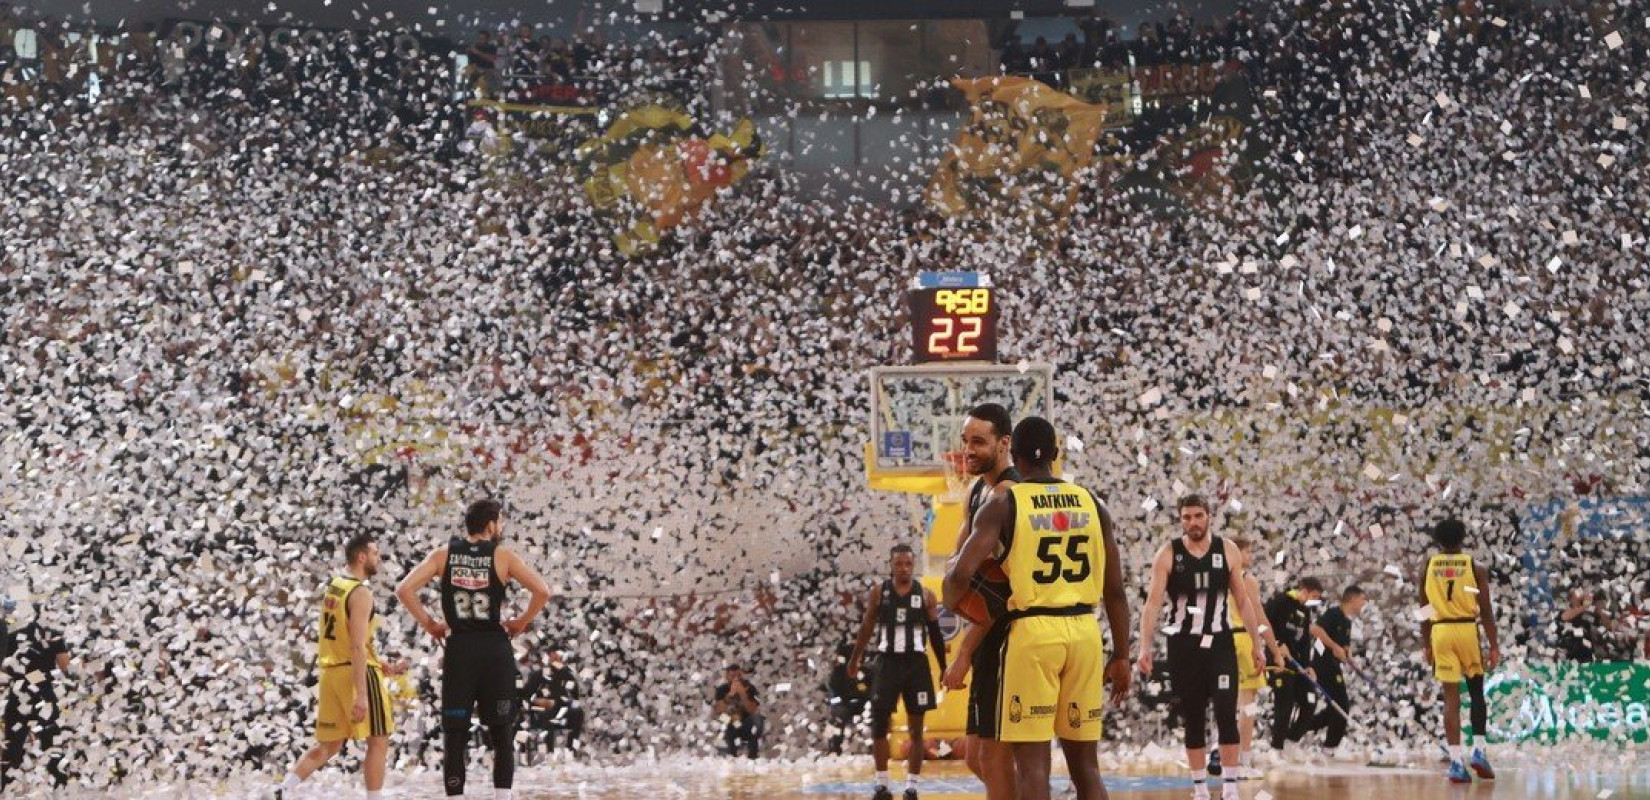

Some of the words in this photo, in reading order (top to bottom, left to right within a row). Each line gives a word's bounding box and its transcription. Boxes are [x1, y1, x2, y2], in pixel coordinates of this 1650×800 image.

[928, 317, 982, 353] 22
[1028, 511, 1090, 532] WOLF
[1032, 535, 1091, 584] 55
[453, 568, 488, 579] KRAFT
[1194, 572, 1210, 589] 11
[1446, 579, 1455, 601] 1
[453, 590, 490, 620] 22
[896, 607, 906, 623] 5
